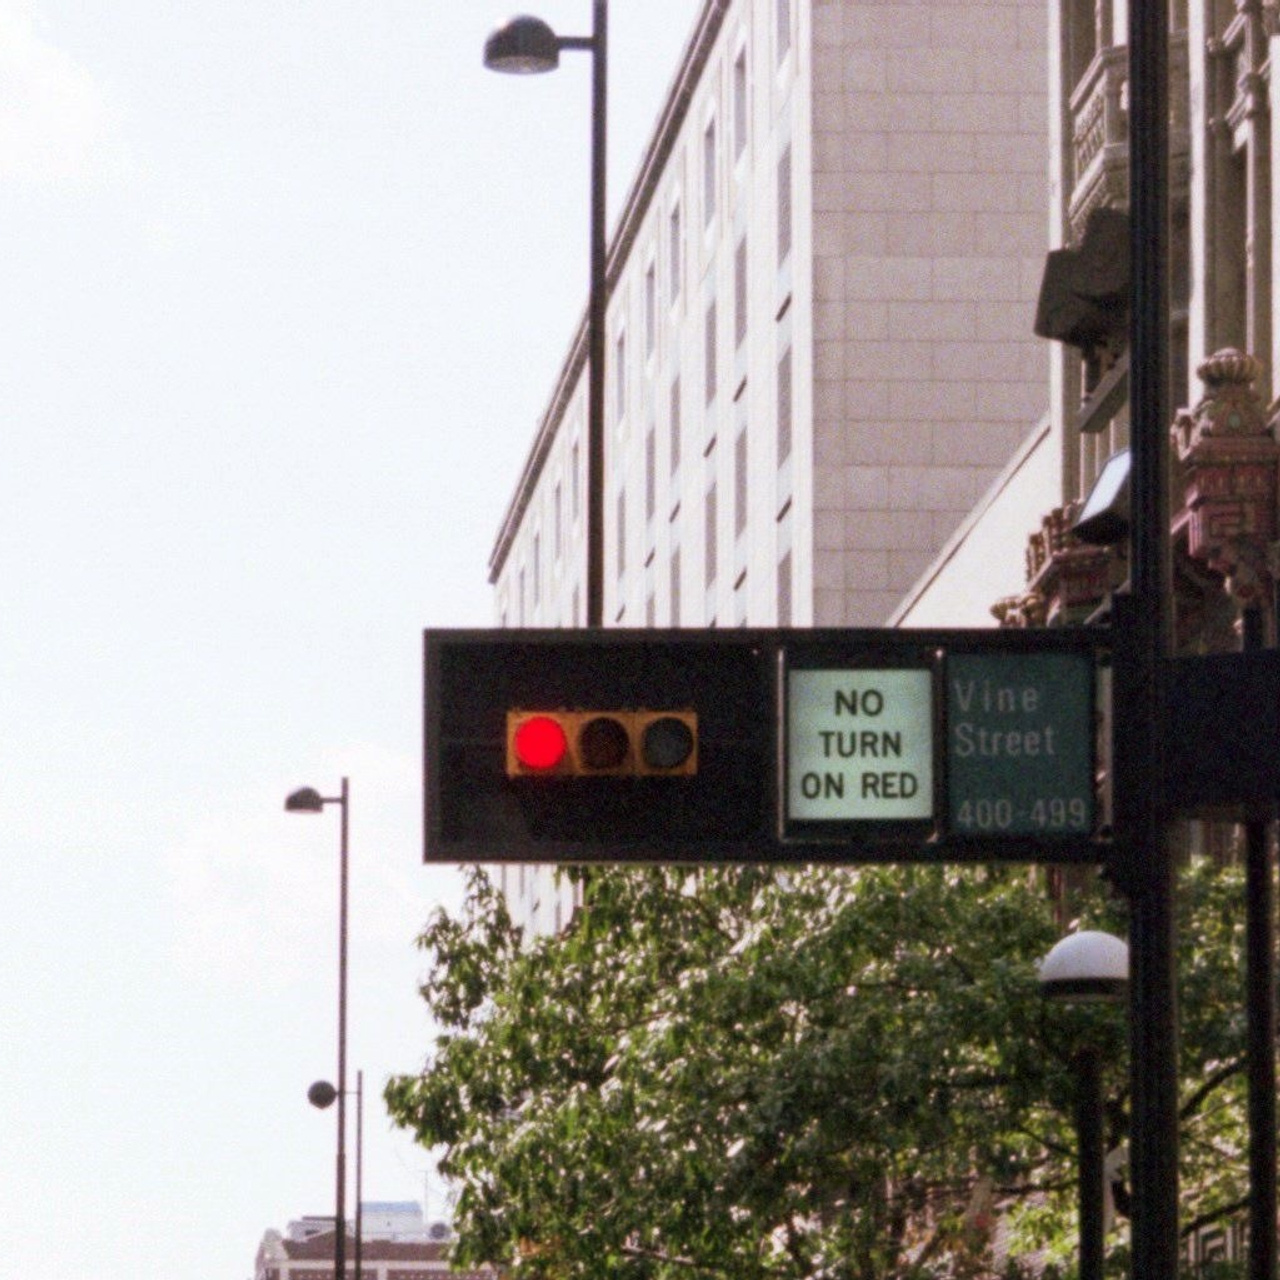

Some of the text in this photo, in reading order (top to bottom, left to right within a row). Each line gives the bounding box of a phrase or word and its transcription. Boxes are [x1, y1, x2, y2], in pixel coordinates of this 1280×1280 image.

[834, 689, 884, 717] NO
[954, 679, 1041, 713] Vine
[818, 731, 902, 758] TURN
[954, 723, 1055, 758] Street
[801, 772, 919, 800] ON RED
